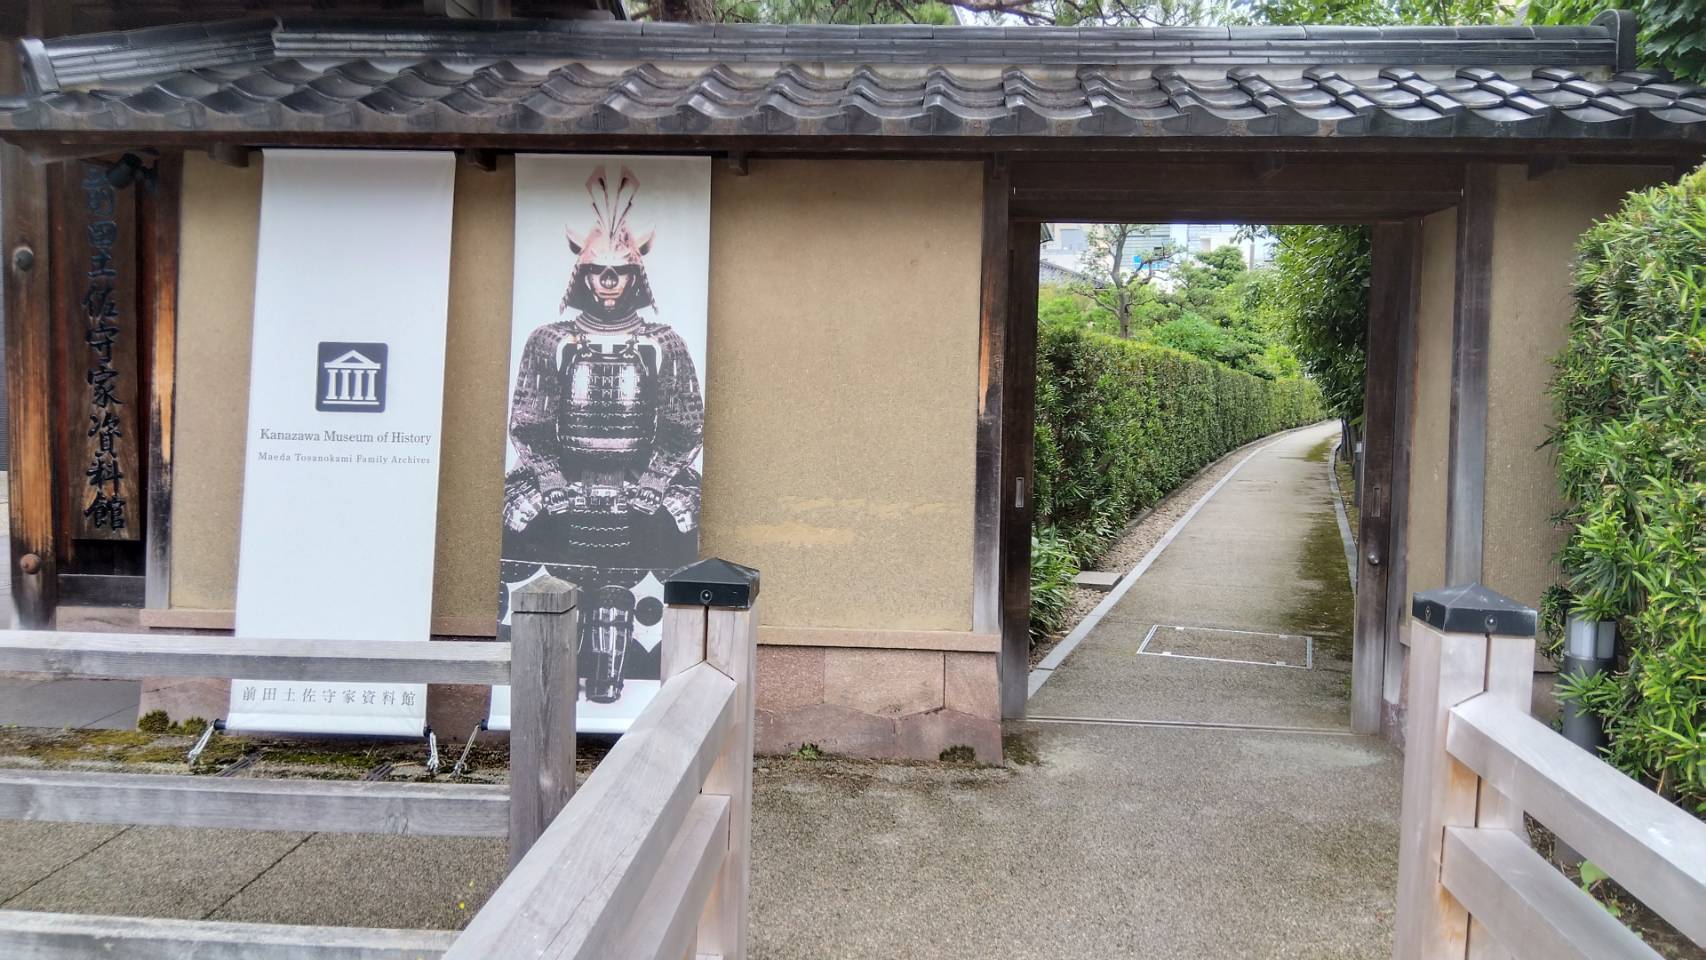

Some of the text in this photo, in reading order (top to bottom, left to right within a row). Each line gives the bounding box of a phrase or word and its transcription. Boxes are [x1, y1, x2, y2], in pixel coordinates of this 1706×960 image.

[260, 428, 431, 445] Kanazawa Museum of History
[257, 452, 431, 465] Maeda Tosanokami Family Archives
[243, 686, 416, 706] 前田土佐守家資料館
